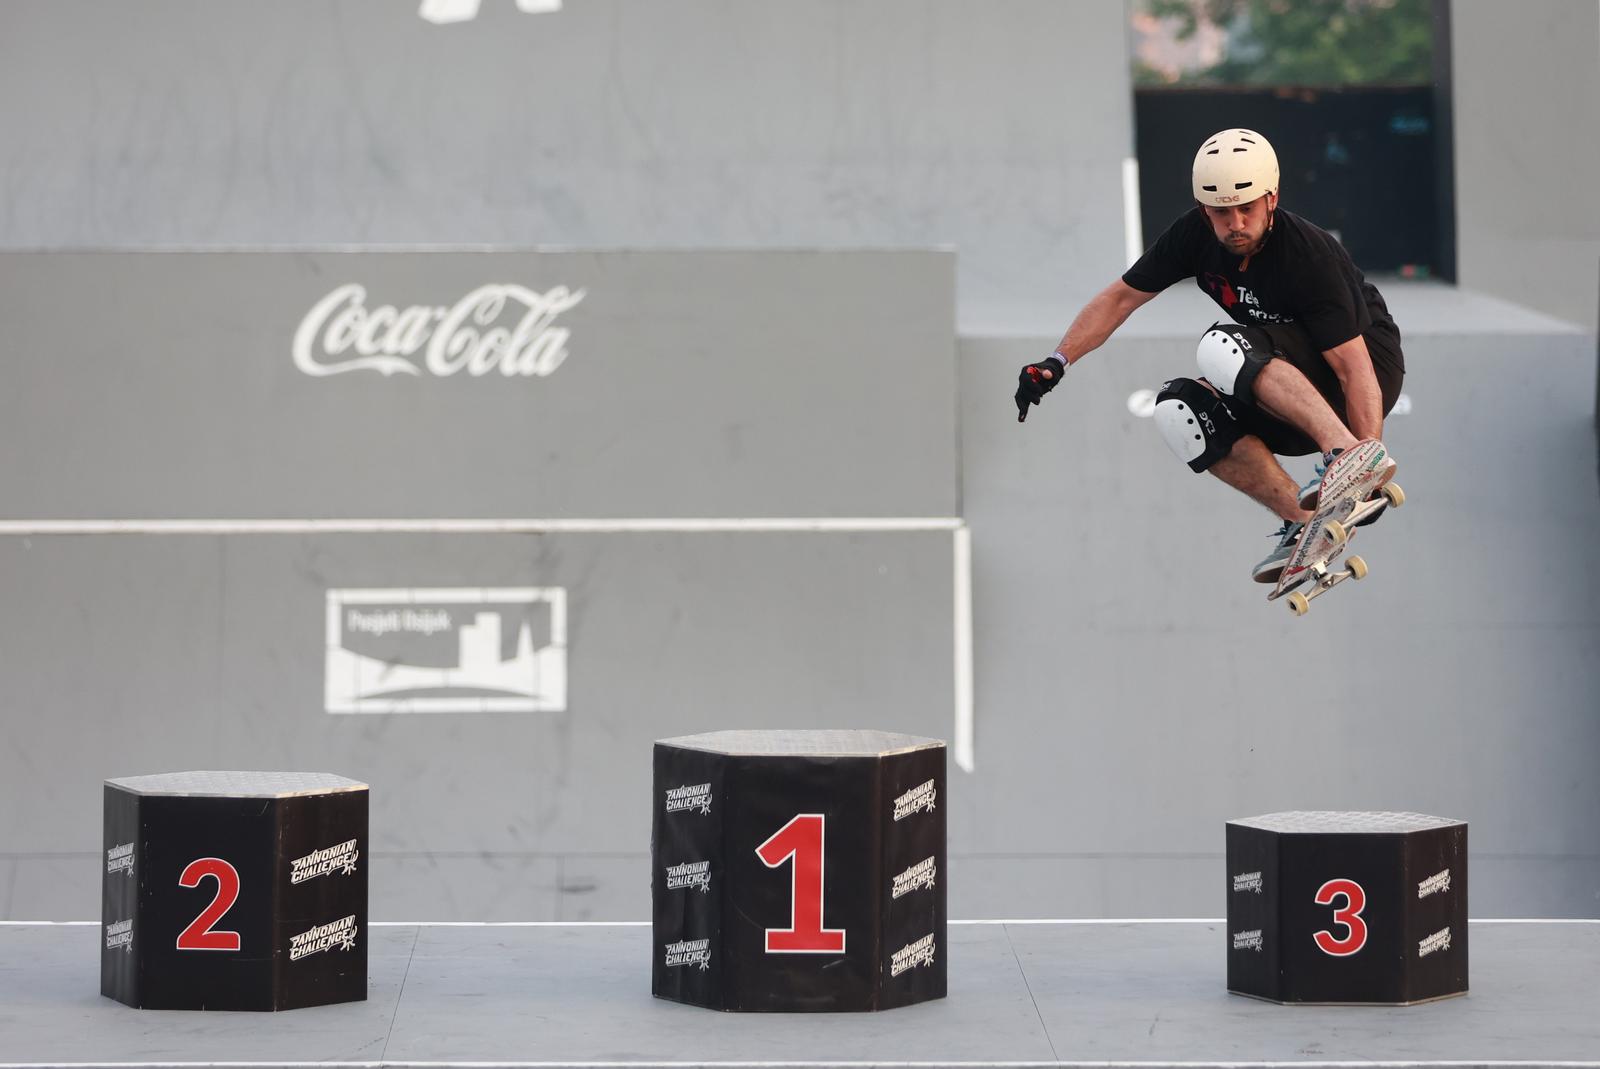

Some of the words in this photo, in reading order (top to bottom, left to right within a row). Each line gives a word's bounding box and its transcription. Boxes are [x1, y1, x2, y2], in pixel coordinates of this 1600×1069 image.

[292, 282, 587, 377] Coca-Cola
[666, 782, 711, 800] PANNONIAN
[666, 794, 708, 811] CHALLENGE
[894, 779, 935, 809] PANNONIAN
[894, 795, 933, 821] CHALLENGE
[291, 839, 357, 871] PANNONIAN
[291, 854, 352, 884] CHALLENGE
[666, 861, 709, 879] PANNONIAN
[667, 873, 708, 889] CHALLENGE
[755, 813, 847, 954] 1
[892, 856, 935, 885] PANNONIAN
[892, 871, 933, 899] CHALLENGE
[176, 857, 241, 951] 2
[1312, 878, 1368, 957] 3
[290, 914, 356, 946] PANNONIAN
[290, 930, 351, 961] CHALLENGE
[665, 939, 710, 956] PANNONIAN
[665, 951, 707, 968] CHALLENGE
[891, 933, 935, 963] PANNONIAN
[891, 948, 932, 977] CHALLENGE
